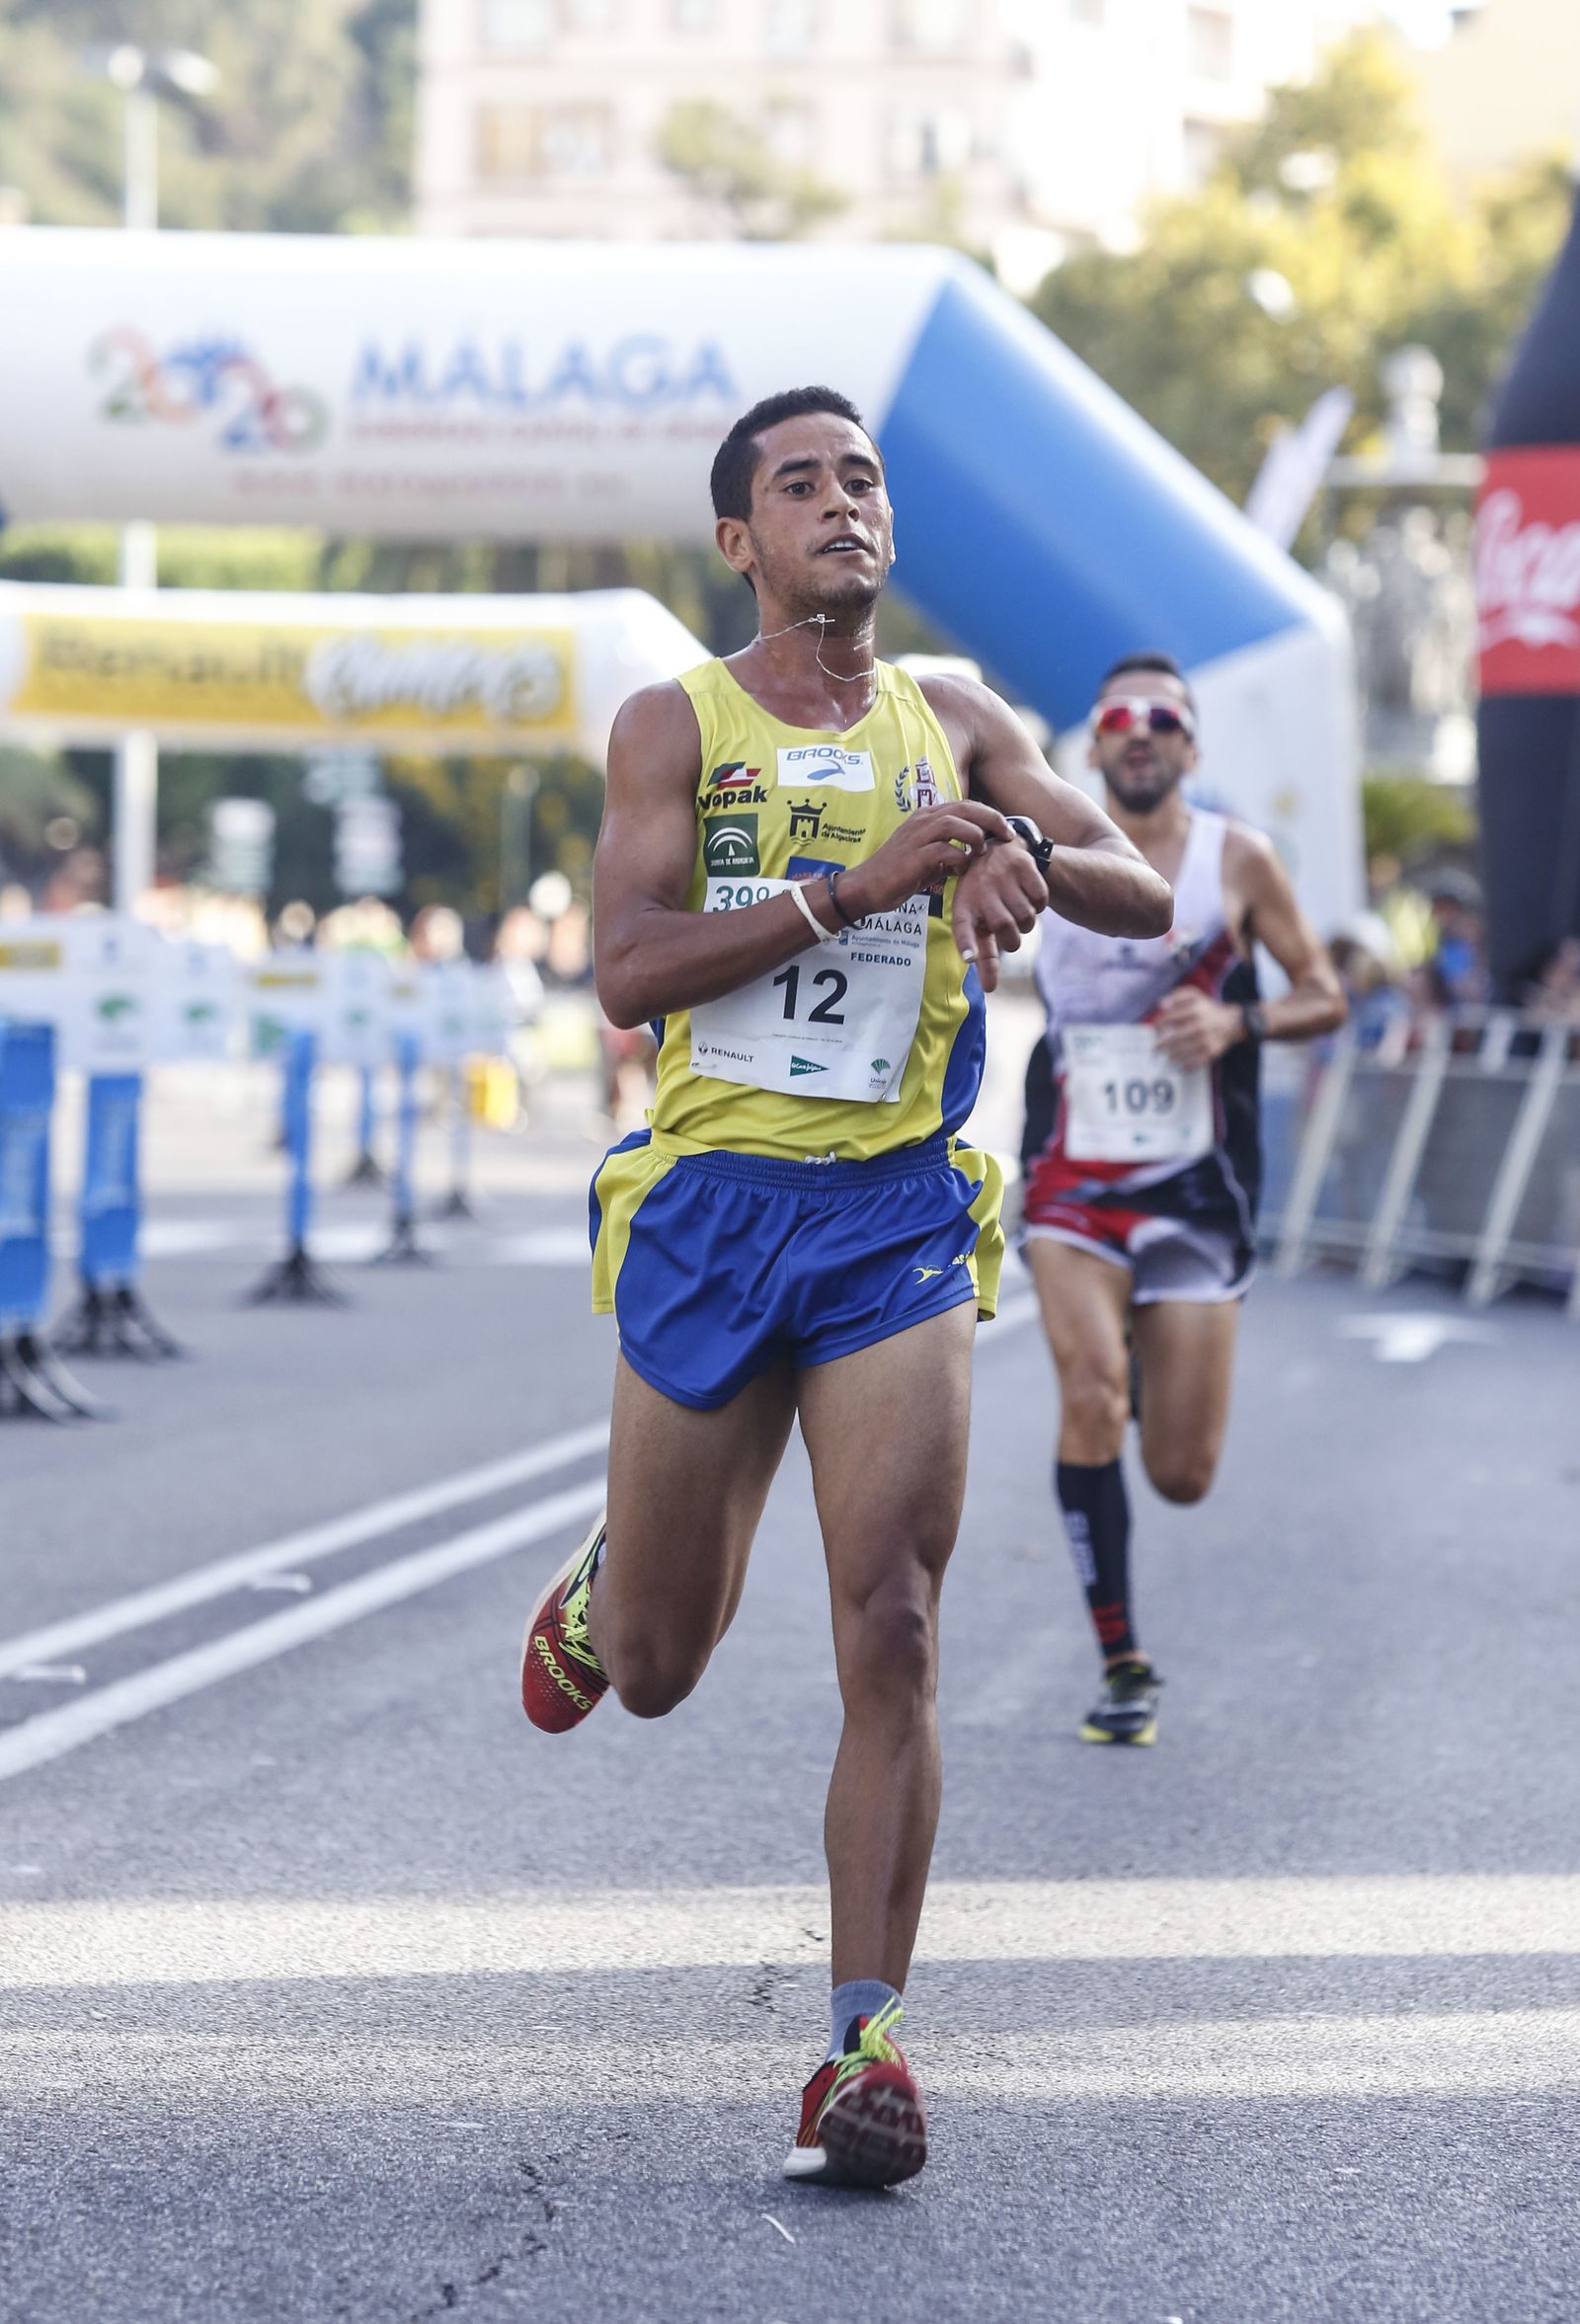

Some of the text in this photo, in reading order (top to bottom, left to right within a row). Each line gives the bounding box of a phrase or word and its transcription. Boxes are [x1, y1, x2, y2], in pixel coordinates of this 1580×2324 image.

[786, 747, 861, 765] BROOKS
[697, 785, 768, 810] Vopak
[850, 952, 911, 967] FEDERADO
[772, 965, 848, 1025] 12
[711, 1046, 754, 1063] RENAULT
[1104, 1078, 1174, 1115] 109
[534, 1635, 593, 1710] BROOKS
